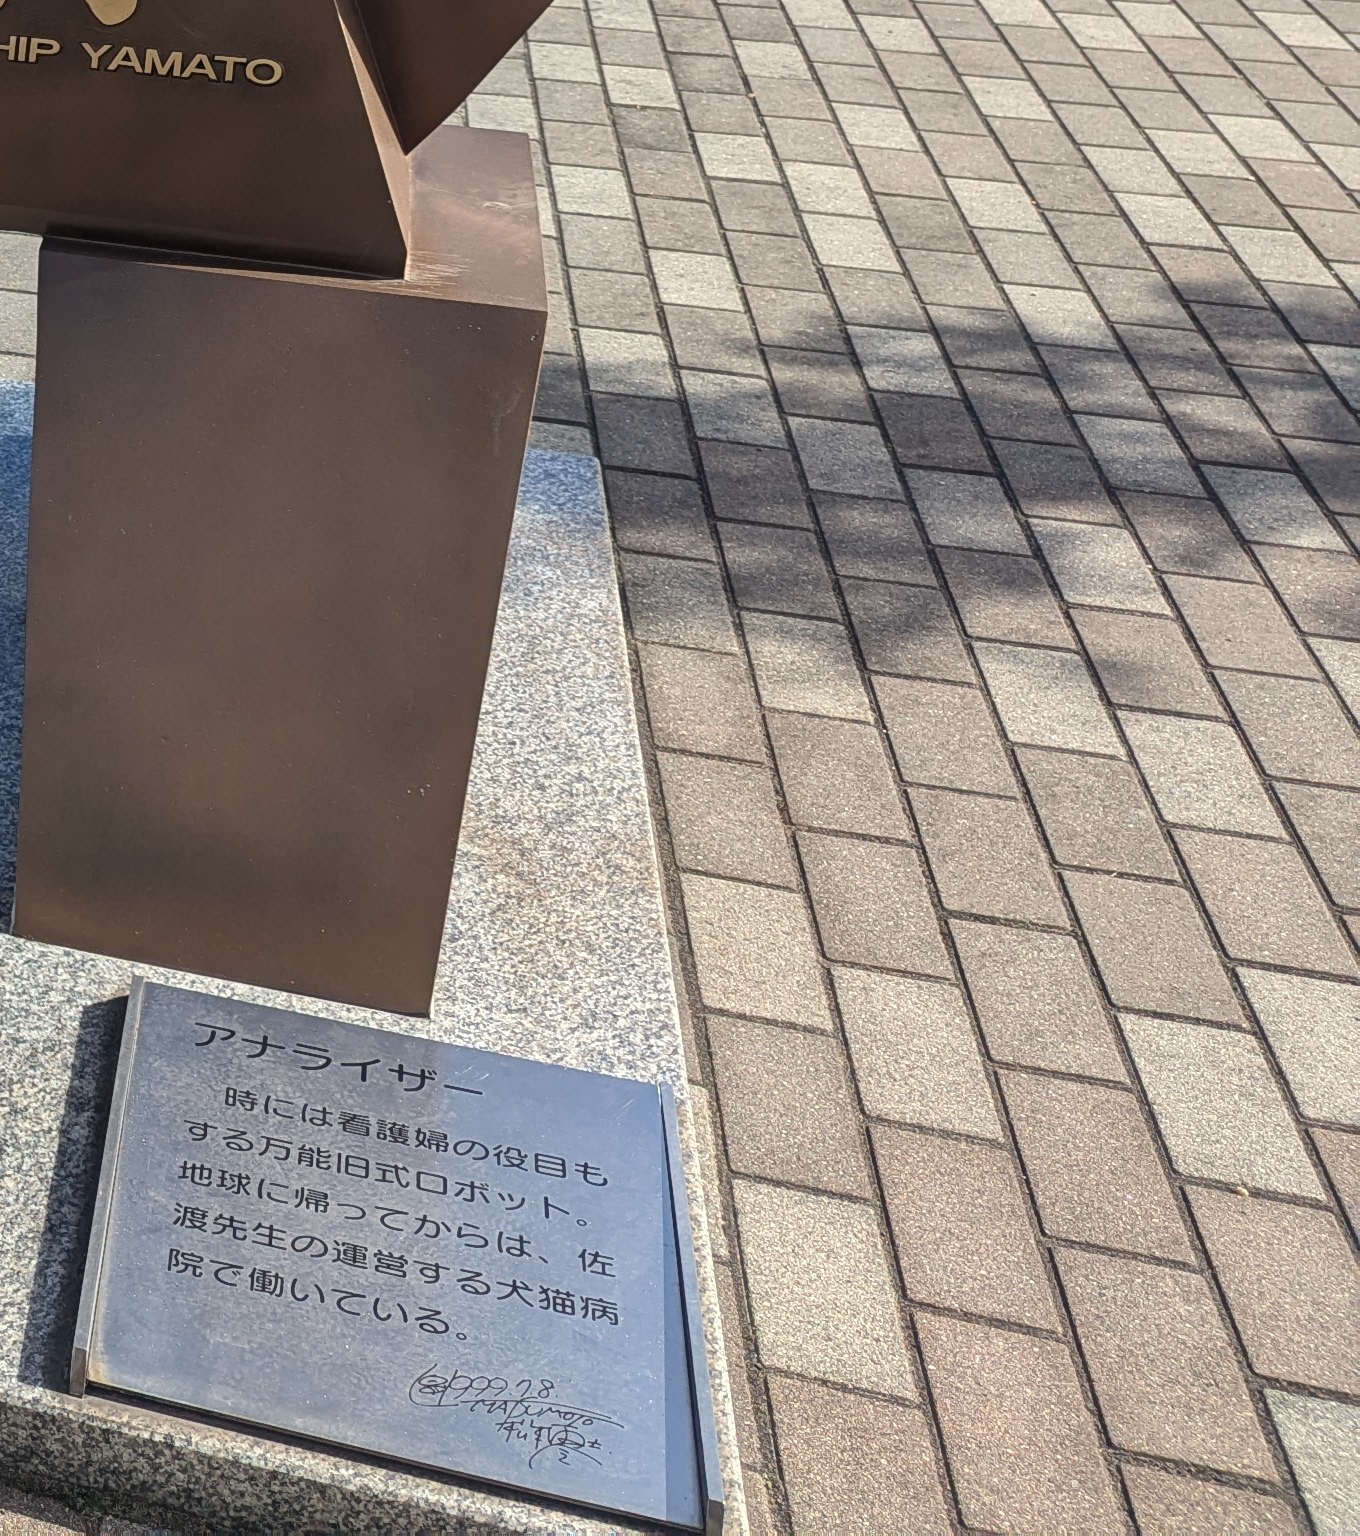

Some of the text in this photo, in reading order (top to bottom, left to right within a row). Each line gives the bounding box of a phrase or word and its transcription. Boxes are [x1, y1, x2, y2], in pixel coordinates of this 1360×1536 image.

[80, 40, 284, 87] YAMATO
[193, 1021, 484, 1097] アナライザー
[183, 1118, 589, 1228] する万能旧式ロボット。
[224, 1085, 609, 1188] 時には看護婦の役目も
[172, 1201, 620, 1327] 渡先生の運営する犬猫病
[176, 1159, 617, 1279] 地球に帰ってからは、佐
[166, 1247, 468, 1342] 院で働いている。
